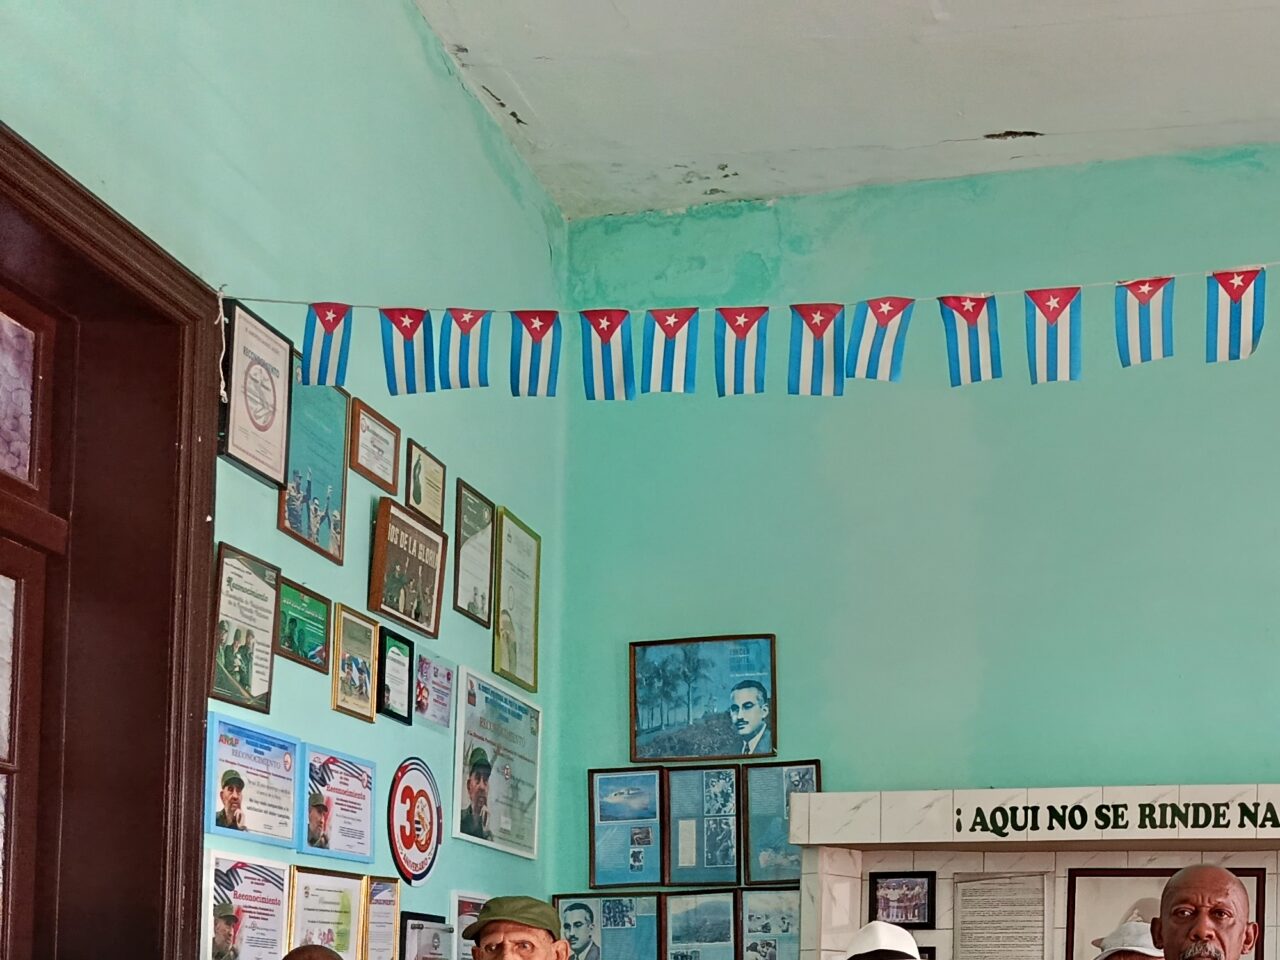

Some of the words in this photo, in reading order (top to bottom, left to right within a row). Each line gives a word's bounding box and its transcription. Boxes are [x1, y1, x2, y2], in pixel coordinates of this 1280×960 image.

[400, 530, 408, 550] DE
[408, 536, 417, 557] LA
[1047, 804, 1088, 830] NO
[1094, 803, 1129, 830] SE
[1138, 802, 1231, 829] RINDE
[233, 890, 281, 906] Reconocimiento
